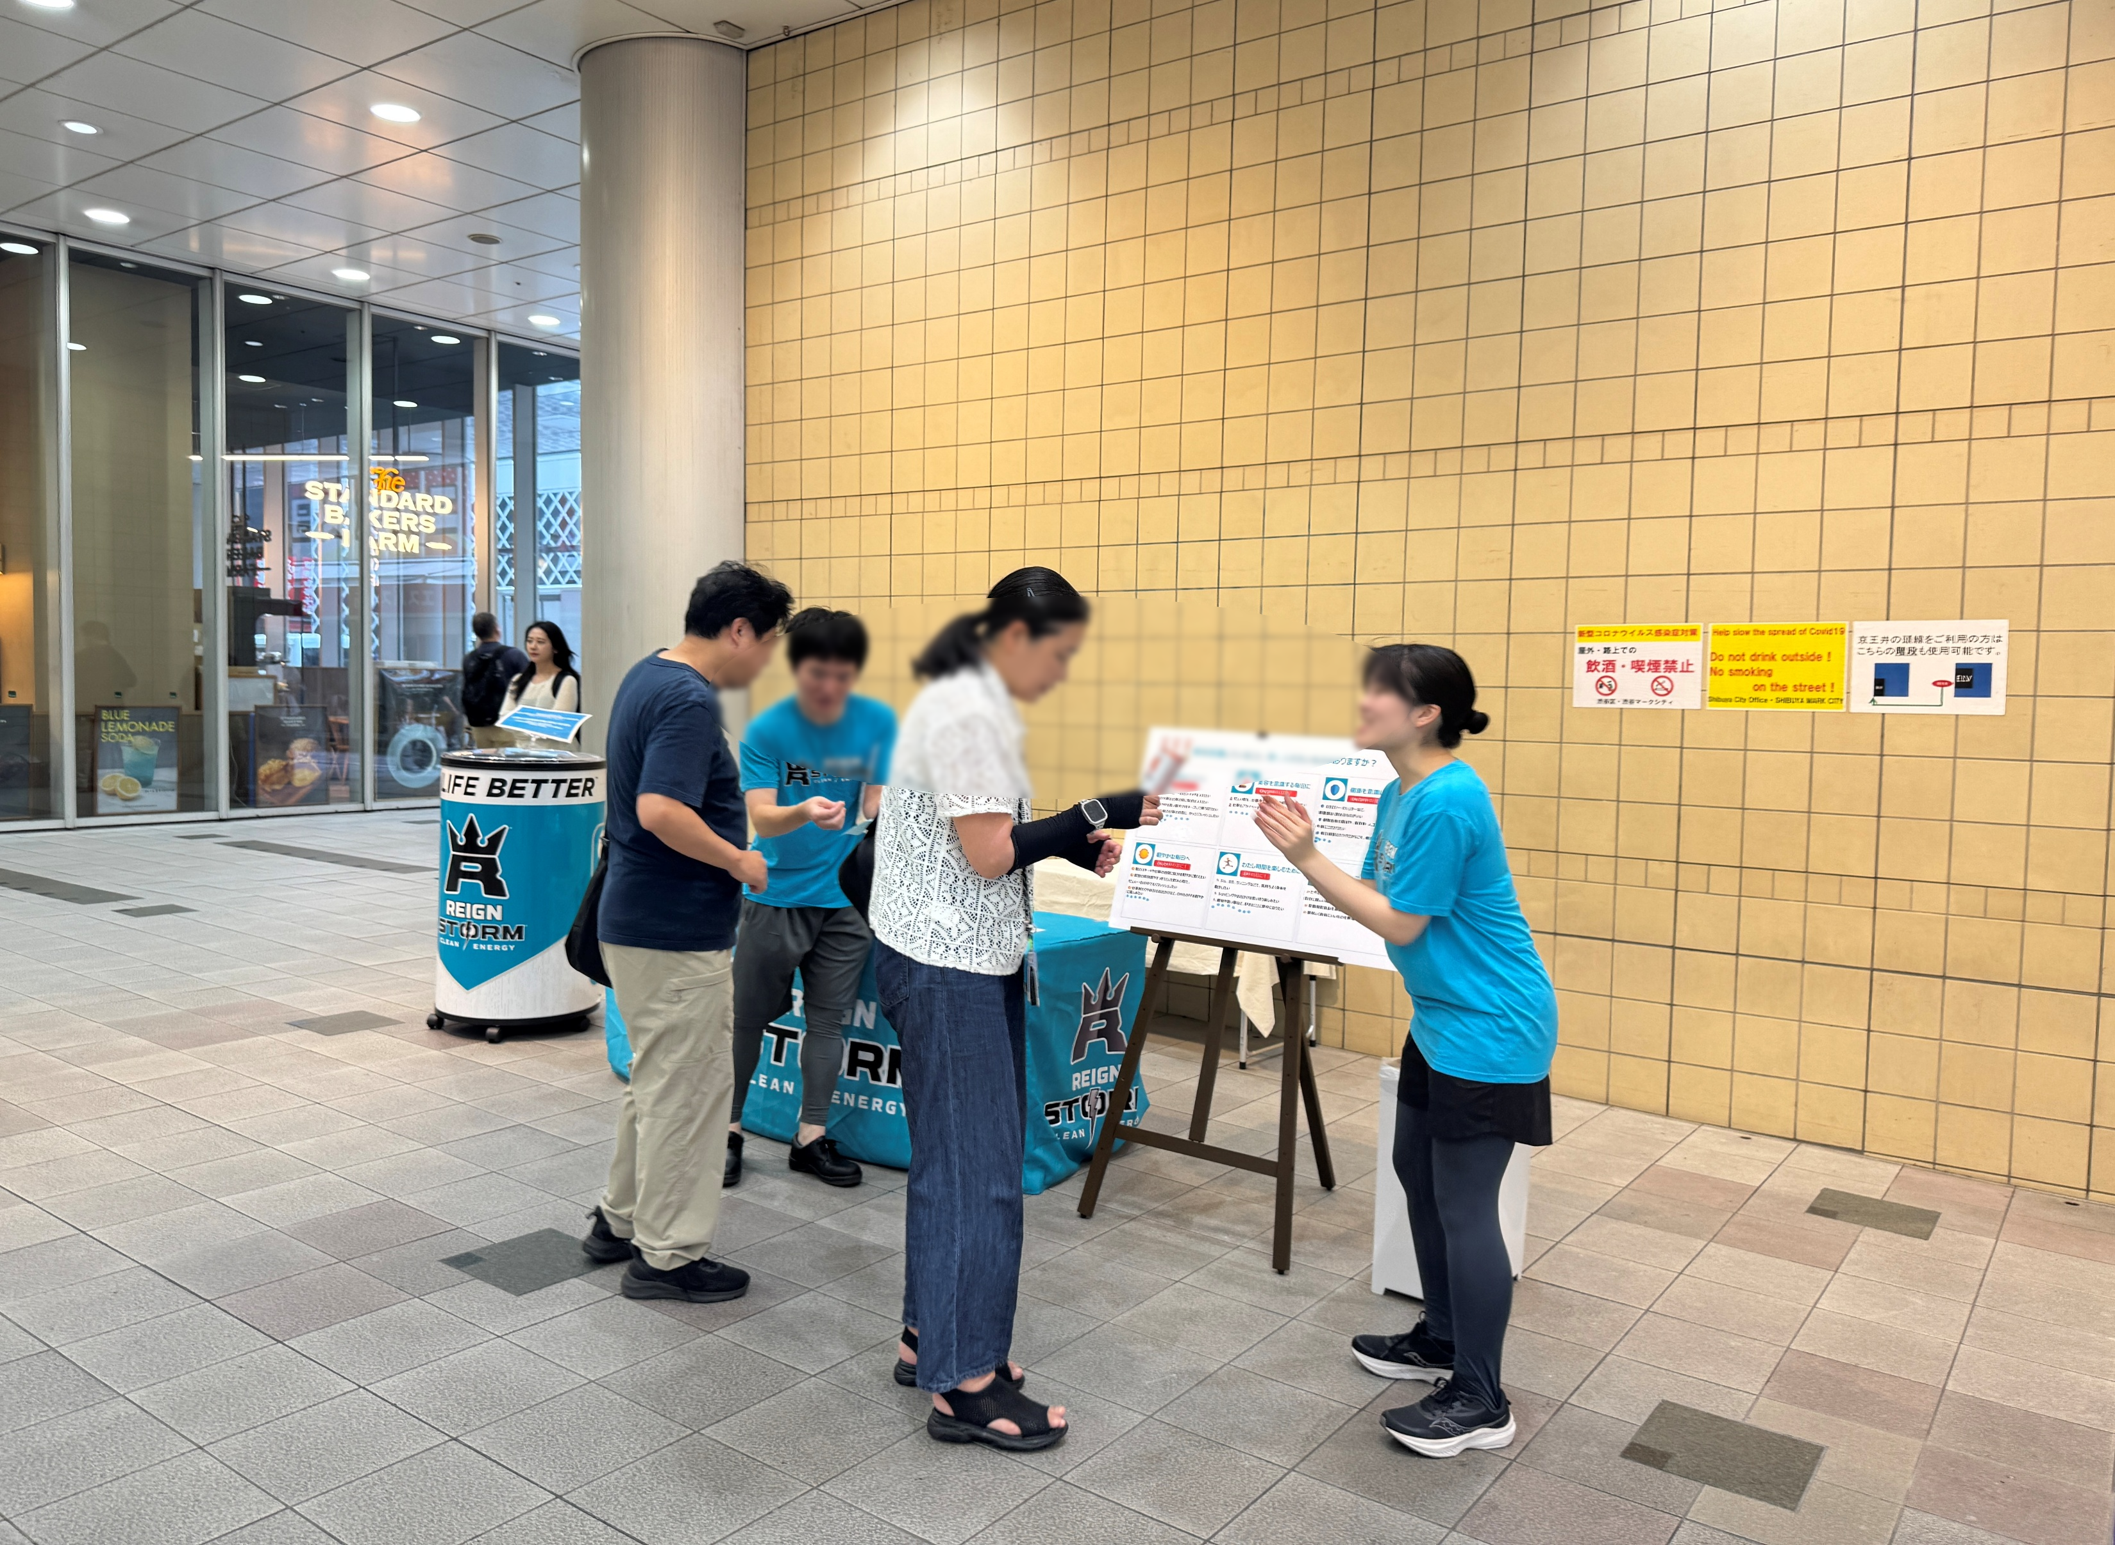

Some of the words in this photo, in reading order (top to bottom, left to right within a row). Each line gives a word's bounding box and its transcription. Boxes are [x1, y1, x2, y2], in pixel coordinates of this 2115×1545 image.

[1712, 628, 1730, 636] Help
[1768, 628, 1796, 636] spread
[1857, 634, 2003, 645] 京王井の頭線をご利用の方は
[1710, 652, 1724, 662] Do
[1728, 652, 1745, 662] not
[1750, 652, 1777, 662] drink
[1586, 659, 1695, 673] 飲酒・喫煙禁止
[1710, 667, 1724, 676] No
[1728, 667, 1773, 678] smoking
[1753, 683, 1766, 692] on
[1770, 682, 1787, 692] the
[1792, 682, 1826, 692] street
[101, 710, 130, 720] BLUE
[101, 721, 175, 732] LEMONADE
[101, 733, 135, 742] SODA
[486, 777, 596, 799] BETTER
[446, 899, 503, 920] REIGN
[439, 917, 525, 941] STORM
[439, 937, 460, 947] CLEAN
[473, 943, 515, 951] ENERGY
